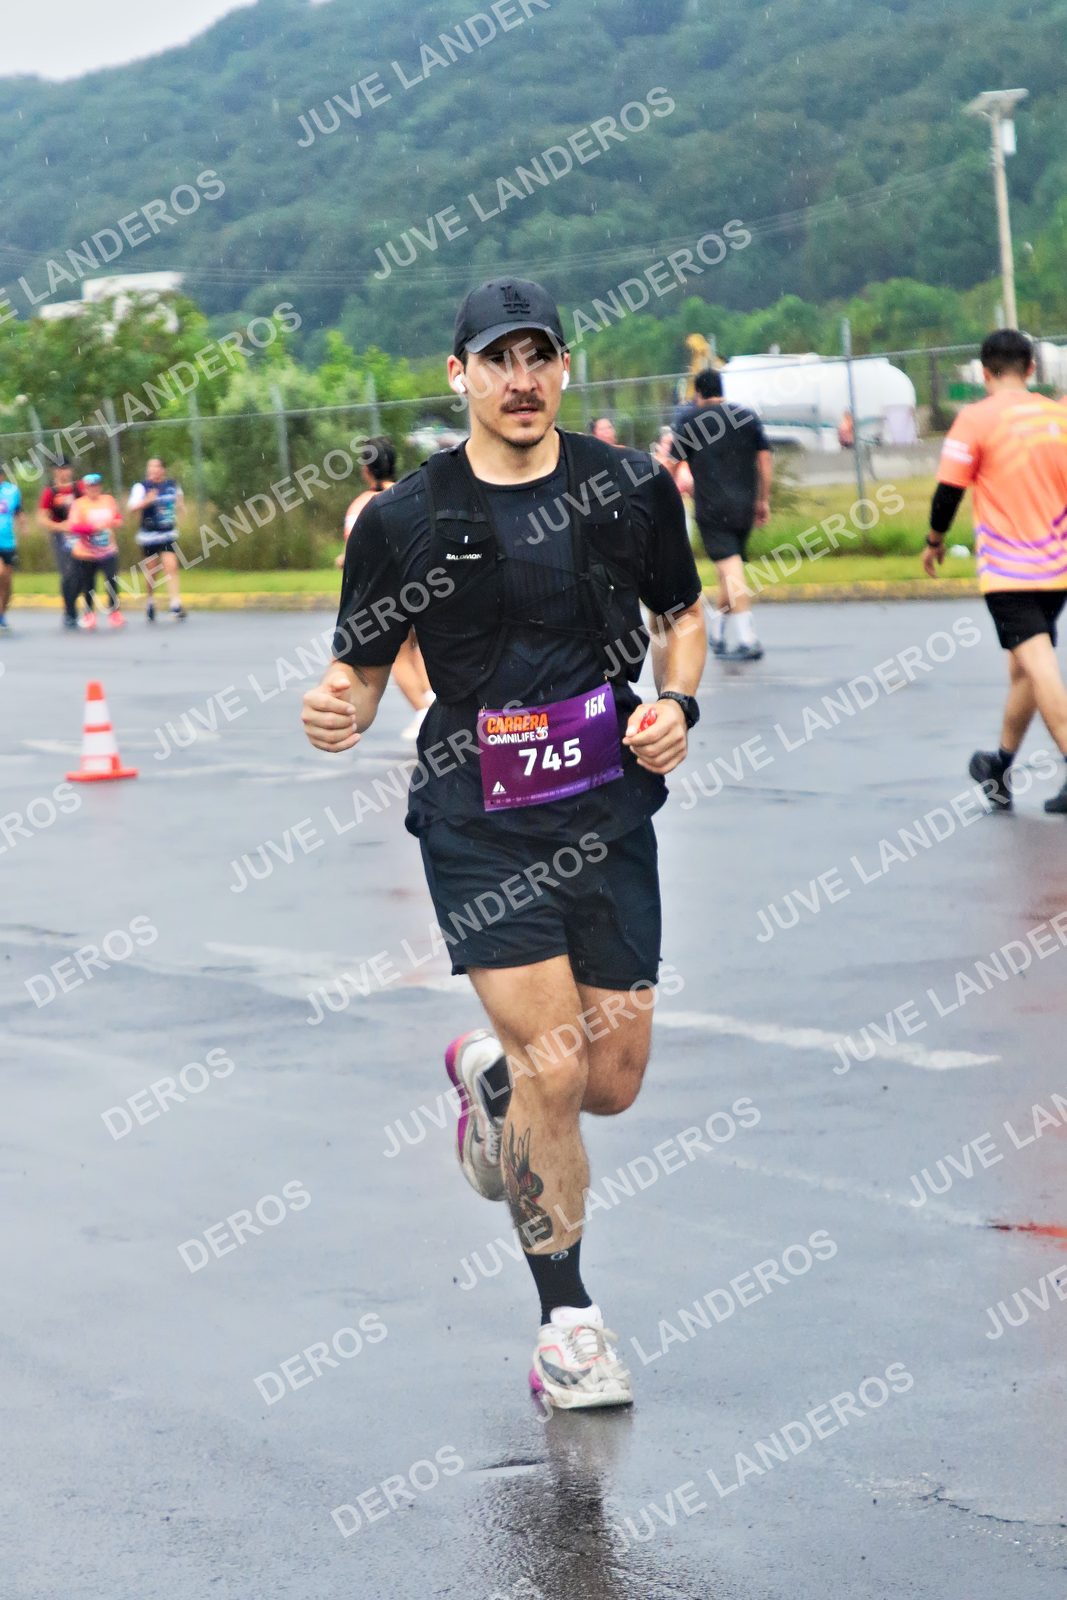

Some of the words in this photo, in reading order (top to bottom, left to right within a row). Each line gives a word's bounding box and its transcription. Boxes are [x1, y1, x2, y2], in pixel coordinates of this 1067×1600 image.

[501, 285, 531, 313] LA
[584, 692, 606, 719] 16K
[487, 712, 549, 734] CARRERA
[518, 737, 582, 776] 745
